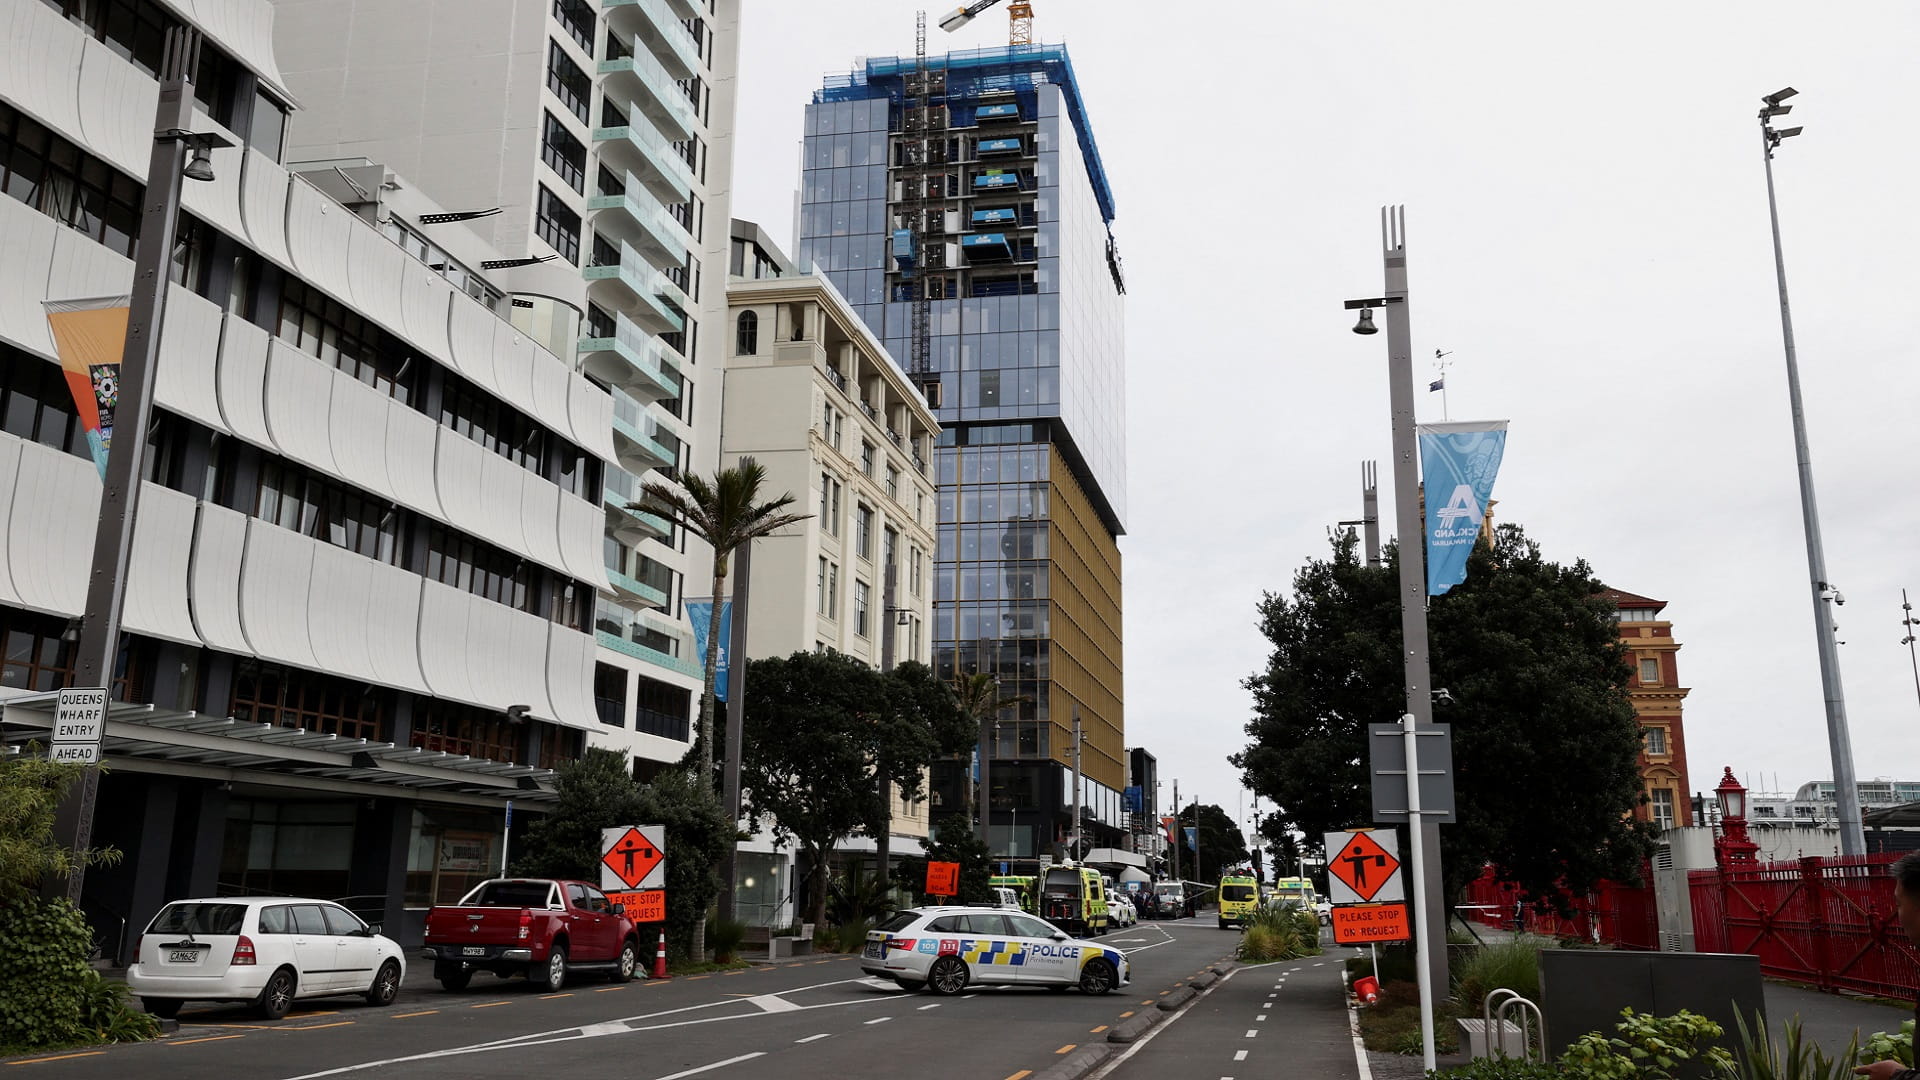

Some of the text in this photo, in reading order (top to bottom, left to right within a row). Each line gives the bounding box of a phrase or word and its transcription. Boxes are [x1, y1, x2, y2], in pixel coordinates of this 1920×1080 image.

[61, 694, 103, 705] QUEENS
[60, 710, 101, 720] WHARF
[60, 725, 95, 736] ENTRY
[56, 748, 92, 759] AHEAD
[610, 894, 661, 905] LEASE STOP
[626, 908, 661, 919] EQUEST
[1340, 910, 1399, 922] PLEASE STOP
[1344, 925, 1400, 937] ON REQUEST
[170, 952, 198, 961] CAM624
[1031, 944, 1079, 958] POLICE
